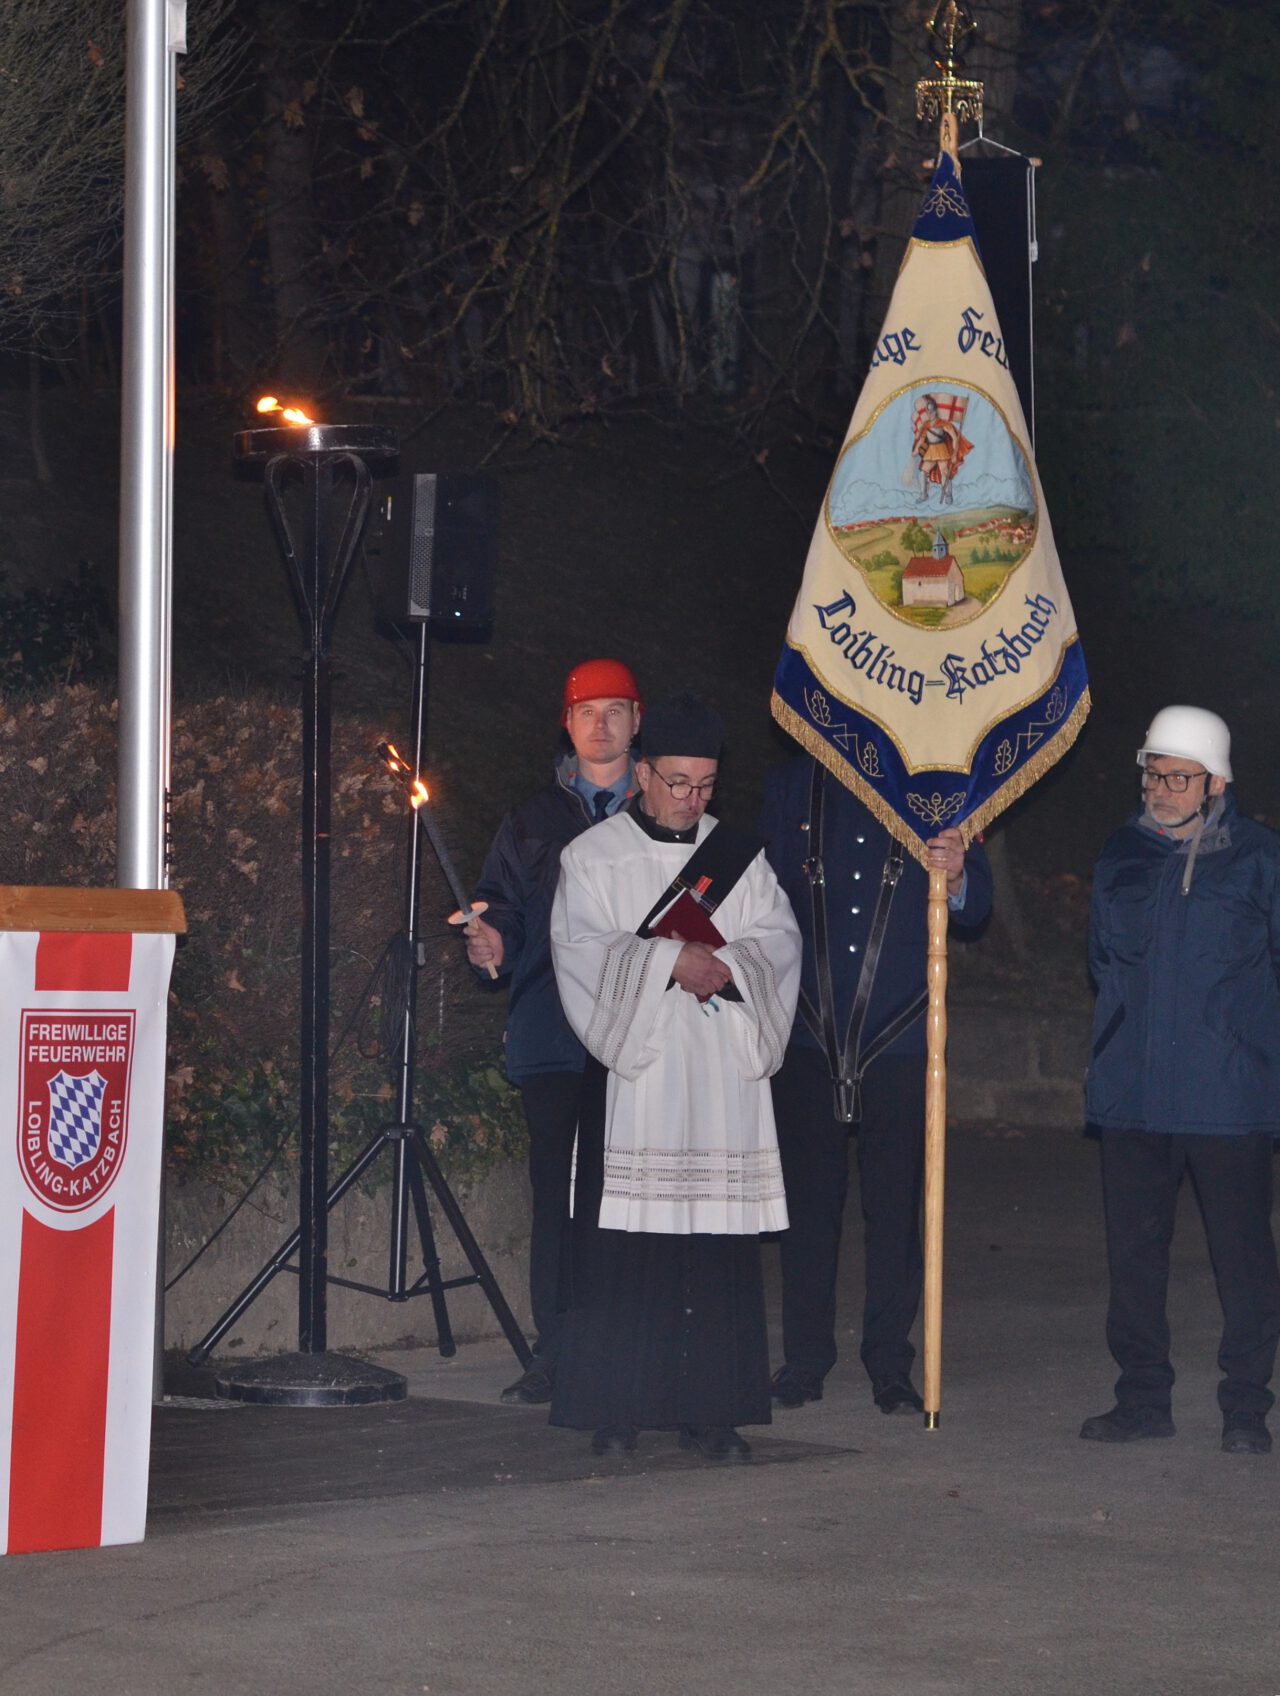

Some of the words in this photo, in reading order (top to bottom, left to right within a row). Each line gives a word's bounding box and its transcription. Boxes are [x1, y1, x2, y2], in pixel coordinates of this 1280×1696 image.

[871, 327, 922, 368] ige
[29, 1023, 127, 1041] FREIWILLIGE
[28, 1045, 126, 1063] FEUERWEHR
[27, 1099, 122, 1196] LOIBLING-KATZBACH
